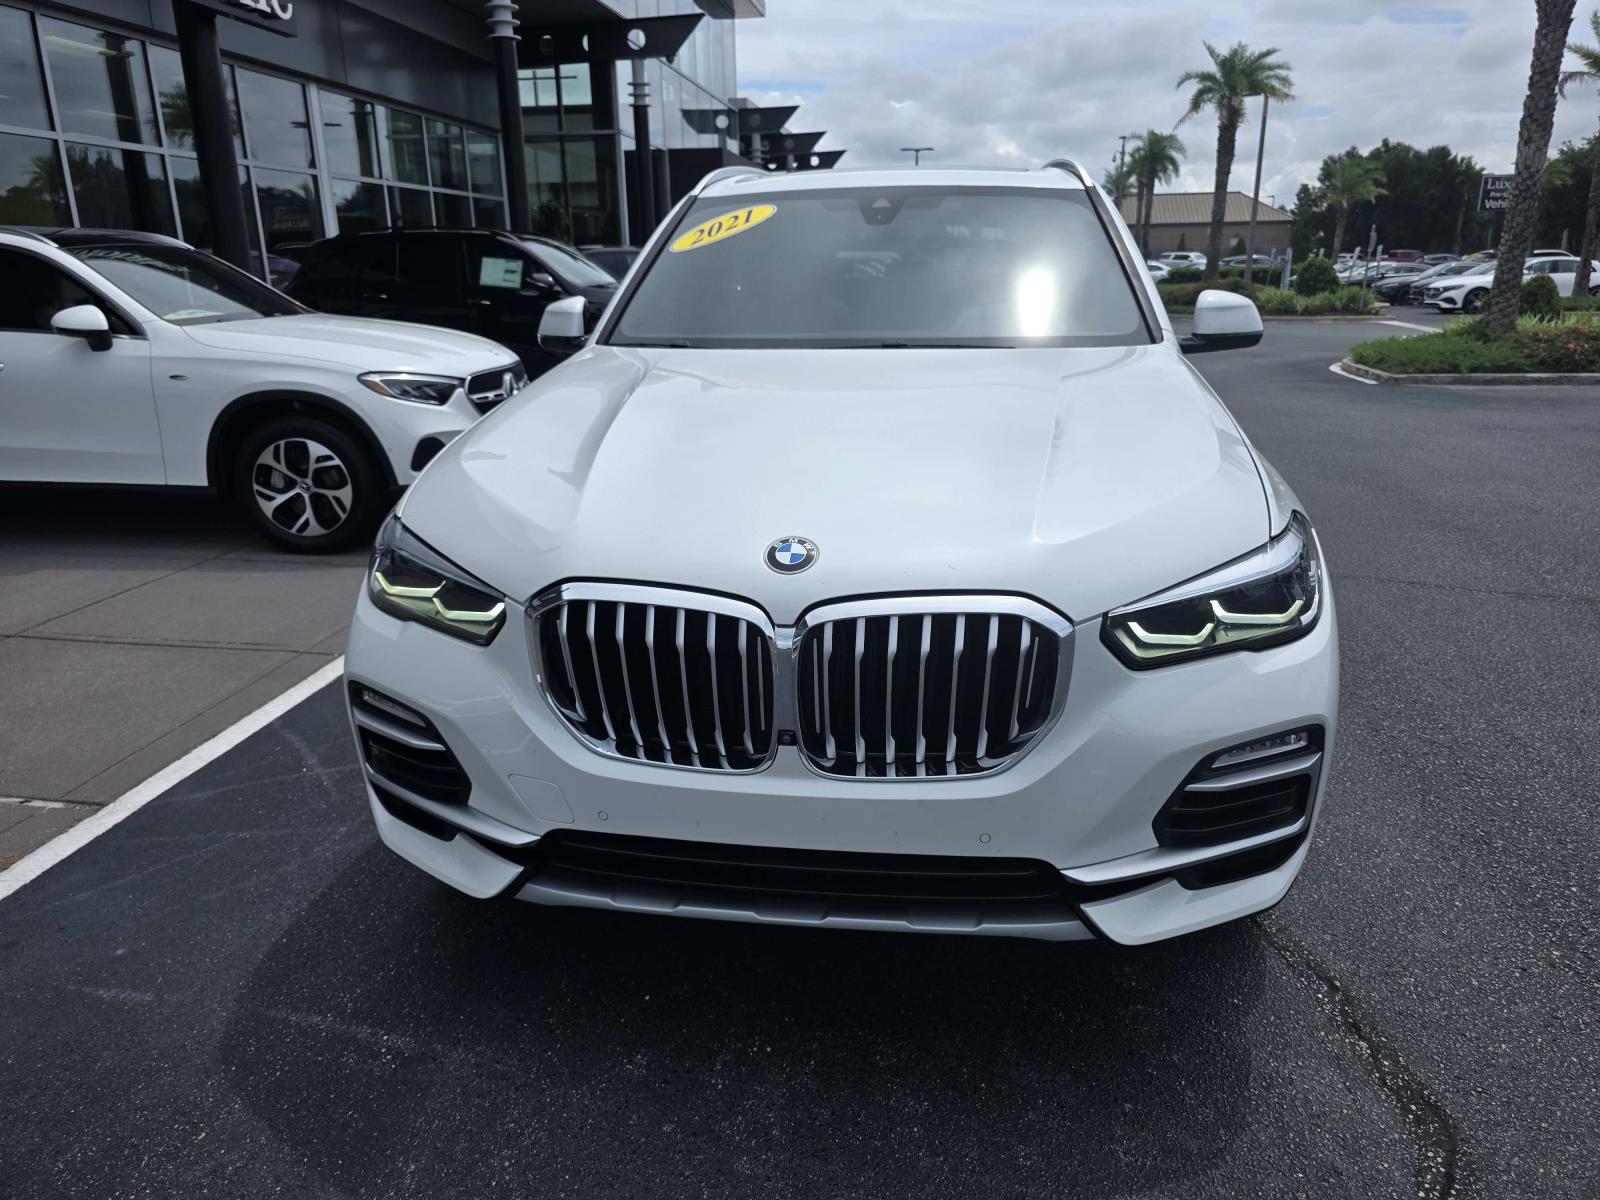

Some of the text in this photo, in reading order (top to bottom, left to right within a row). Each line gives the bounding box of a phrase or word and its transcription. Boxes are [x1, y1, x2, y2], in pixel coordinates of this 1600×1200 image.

[1487, 178, 1511, 190] Lux
[690, 209, 753, 247] 2021
[773, 538, 815, 550] BMW
